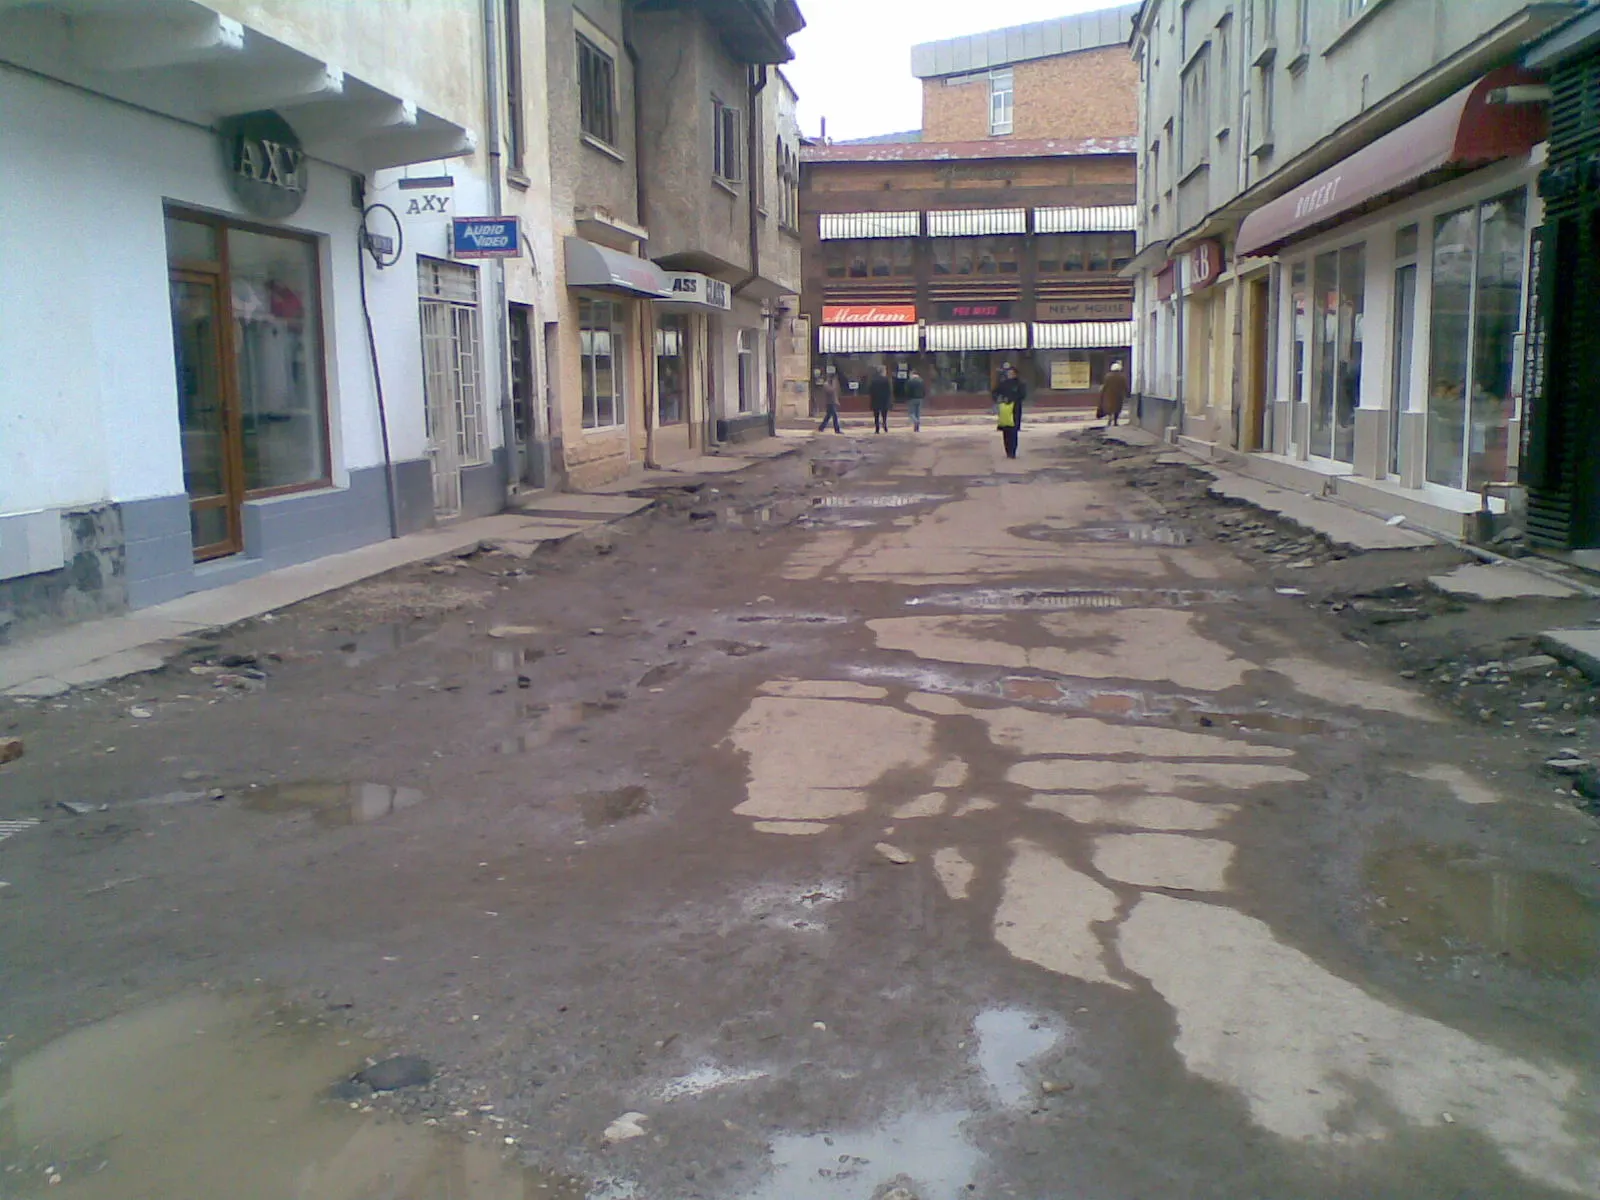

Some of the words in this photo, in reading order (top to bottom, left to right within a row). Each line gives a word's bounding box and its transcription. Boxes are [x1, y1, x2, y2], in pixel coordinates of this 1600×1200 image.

[239, 138, 303, 192] AXY
[406, 194, 451, 215] AXY
[464, 223, 505, 238] AUDIO
[472, 234, 509, 248] VIDEO
[673, 278, 697, 292] ASS
[826, 307, 911, 322] Madam
[1050, 304, 1080, 314] NEW
[1085, 302, 1125, 313] HOUSE
